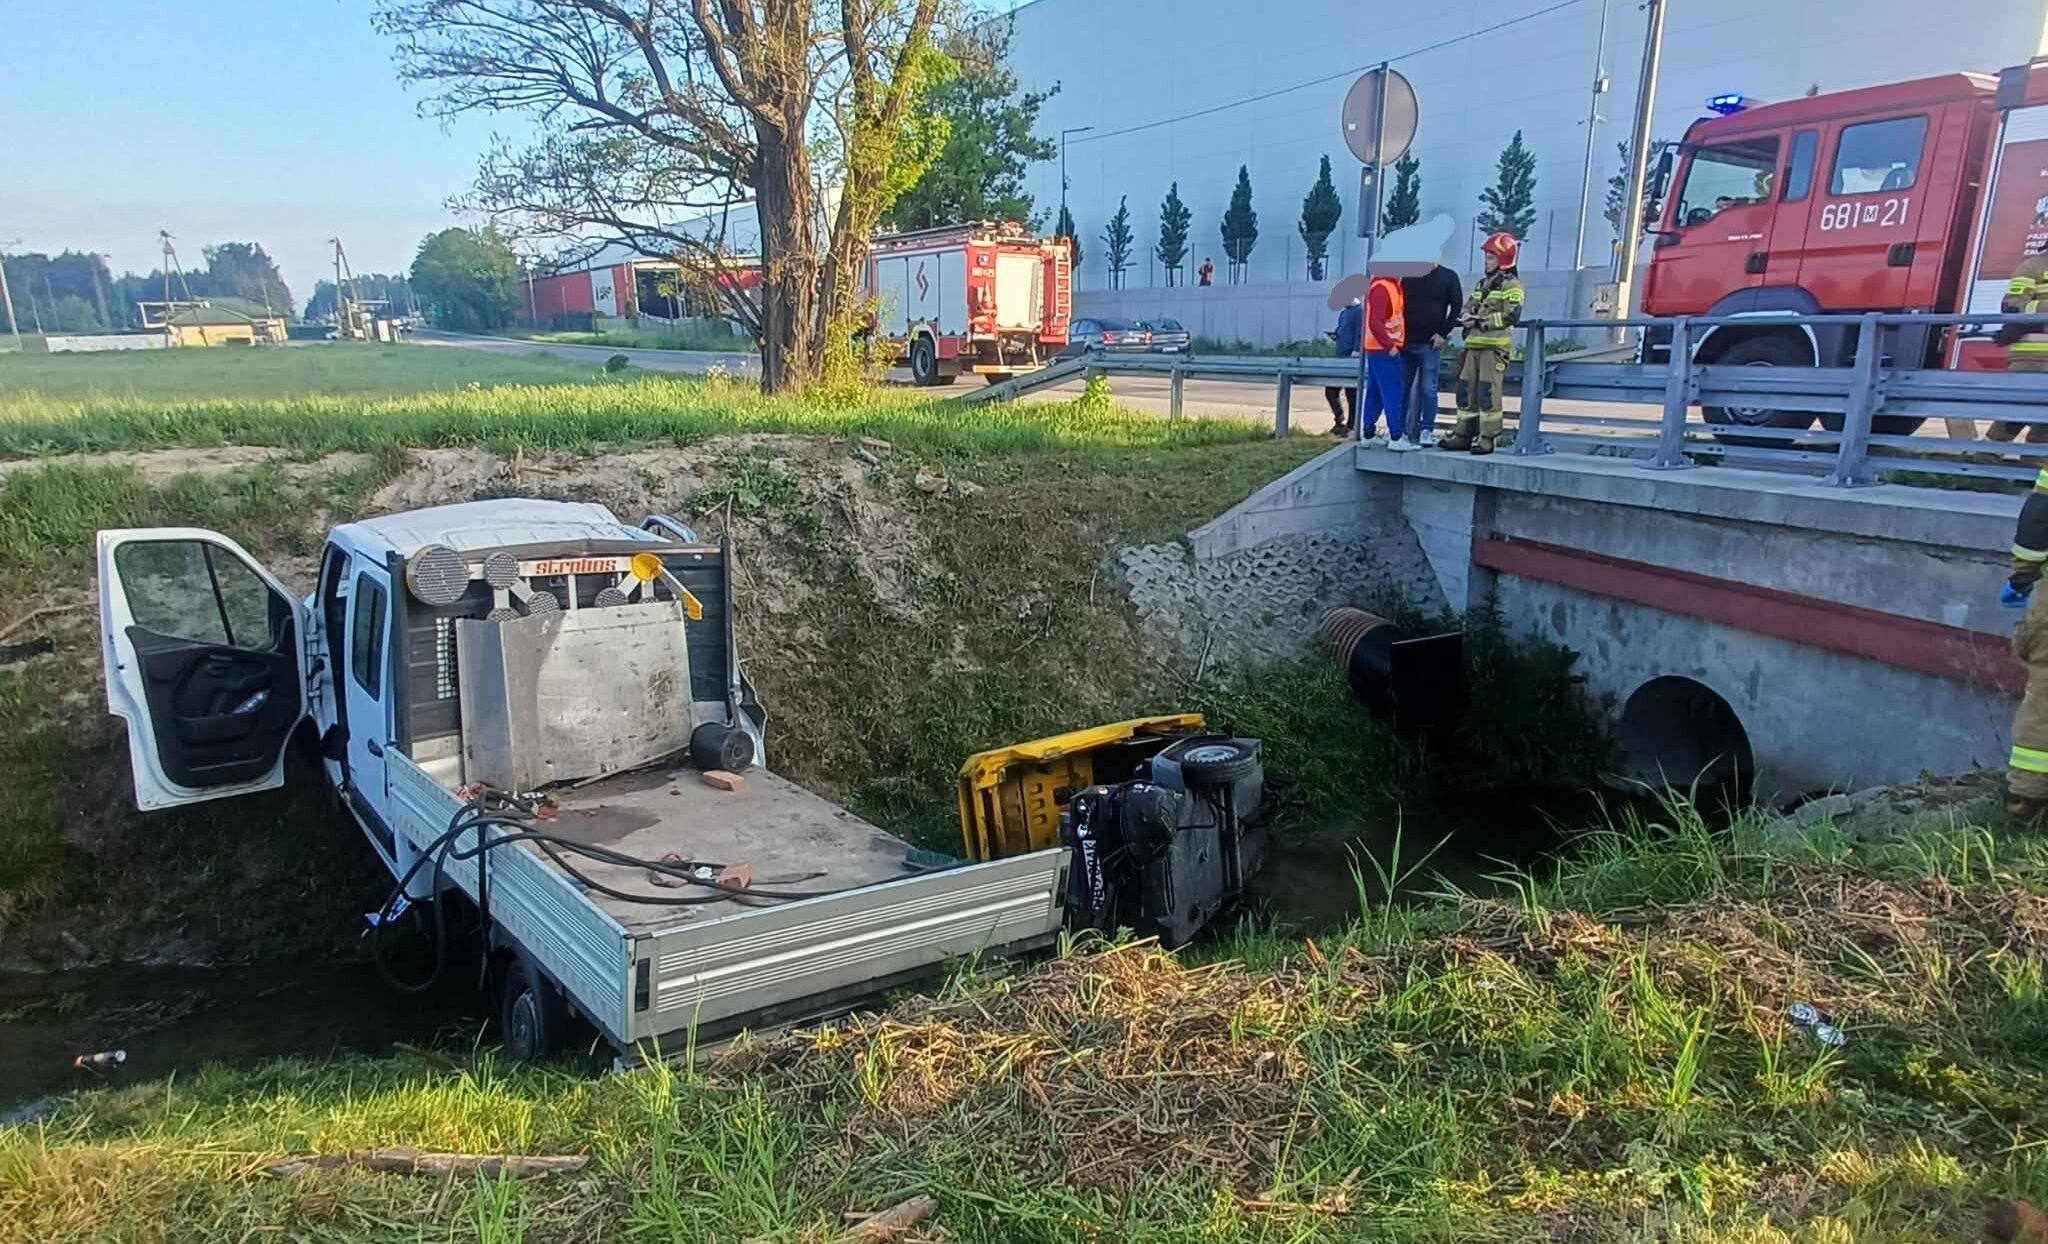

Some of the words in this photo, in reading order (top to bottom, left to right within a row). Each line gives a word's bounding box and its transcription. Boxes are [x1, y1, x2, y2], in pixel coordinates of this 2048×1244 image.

[1820, 202, 1861, 230] 681
[1864, 205, 1878, 222] M
[1880, 198, 1910, 226] 21
